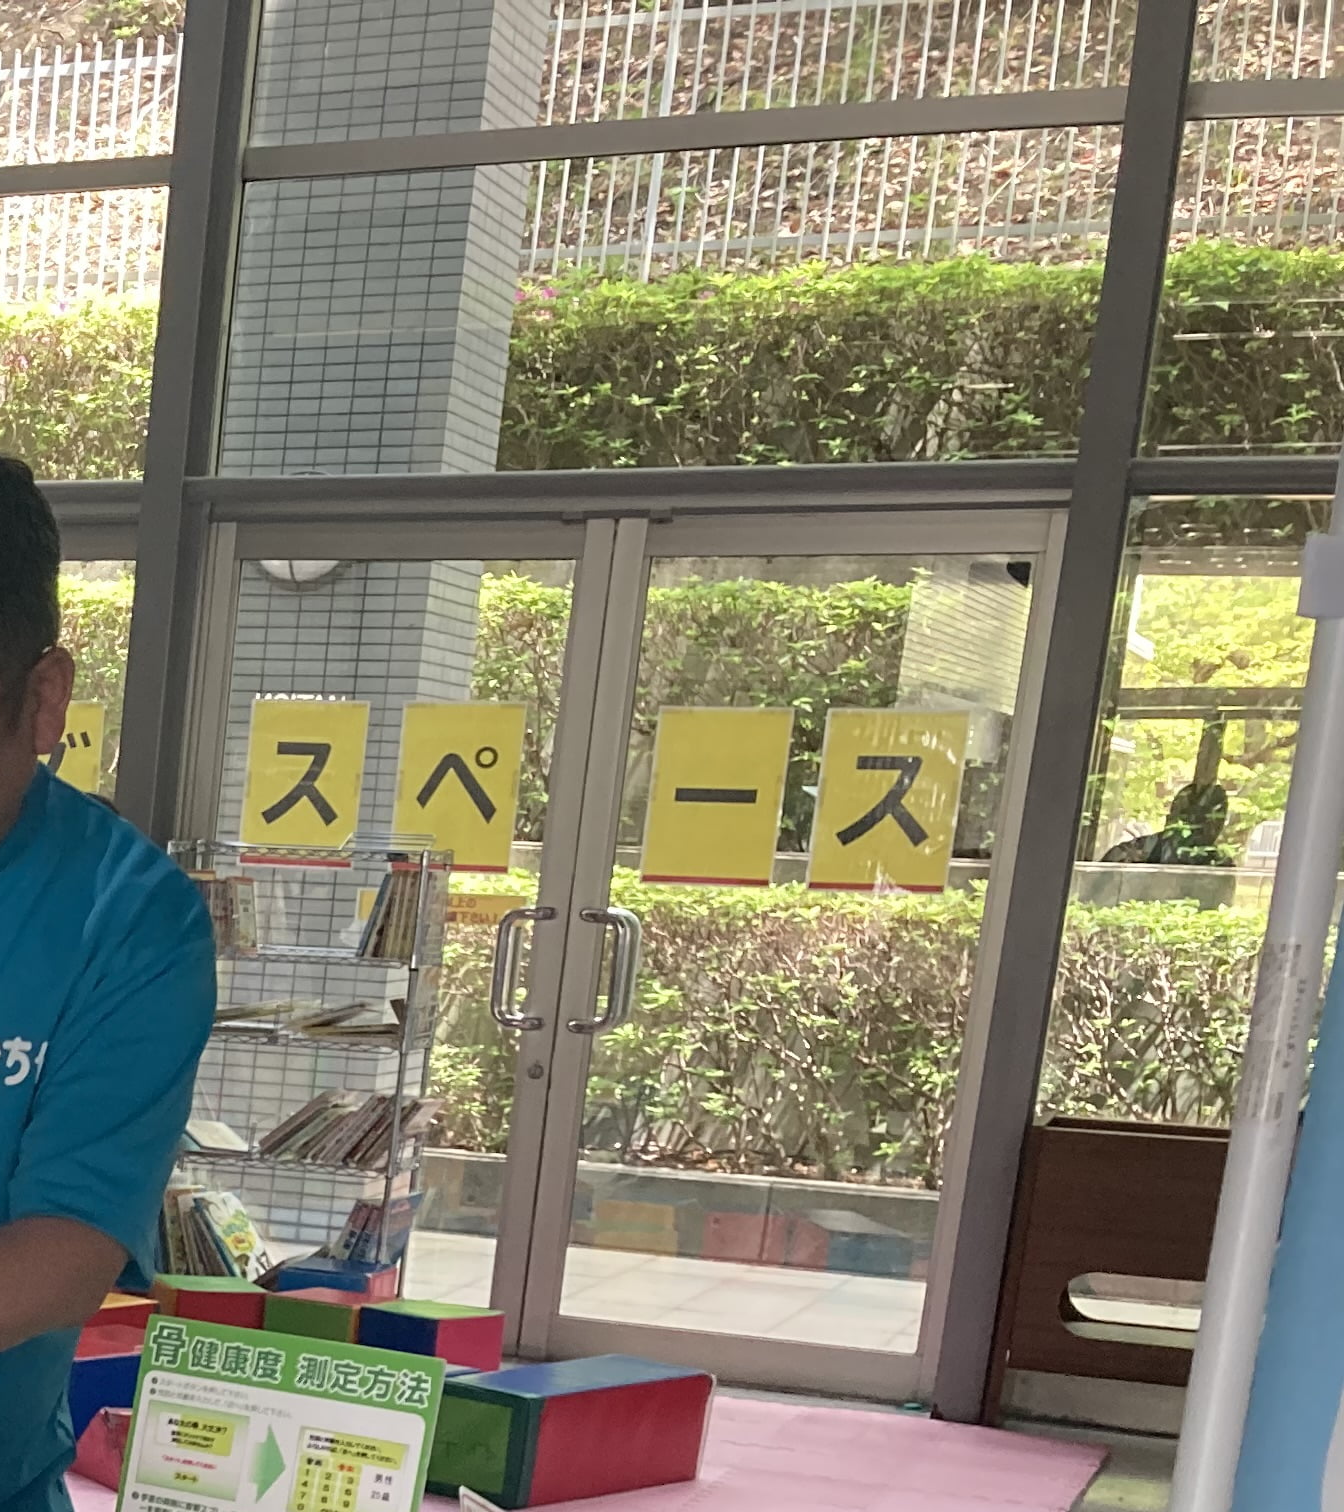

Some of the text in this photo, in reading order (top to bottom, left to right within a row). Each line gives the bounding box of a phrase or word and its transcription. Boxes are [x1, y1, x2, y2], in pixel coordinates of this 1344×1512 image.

[261, 741, 929, 848] スペース
[150, 1324, 285, 1384] 骨健康度
[295, 1355, 431, 1408] 測定方法
